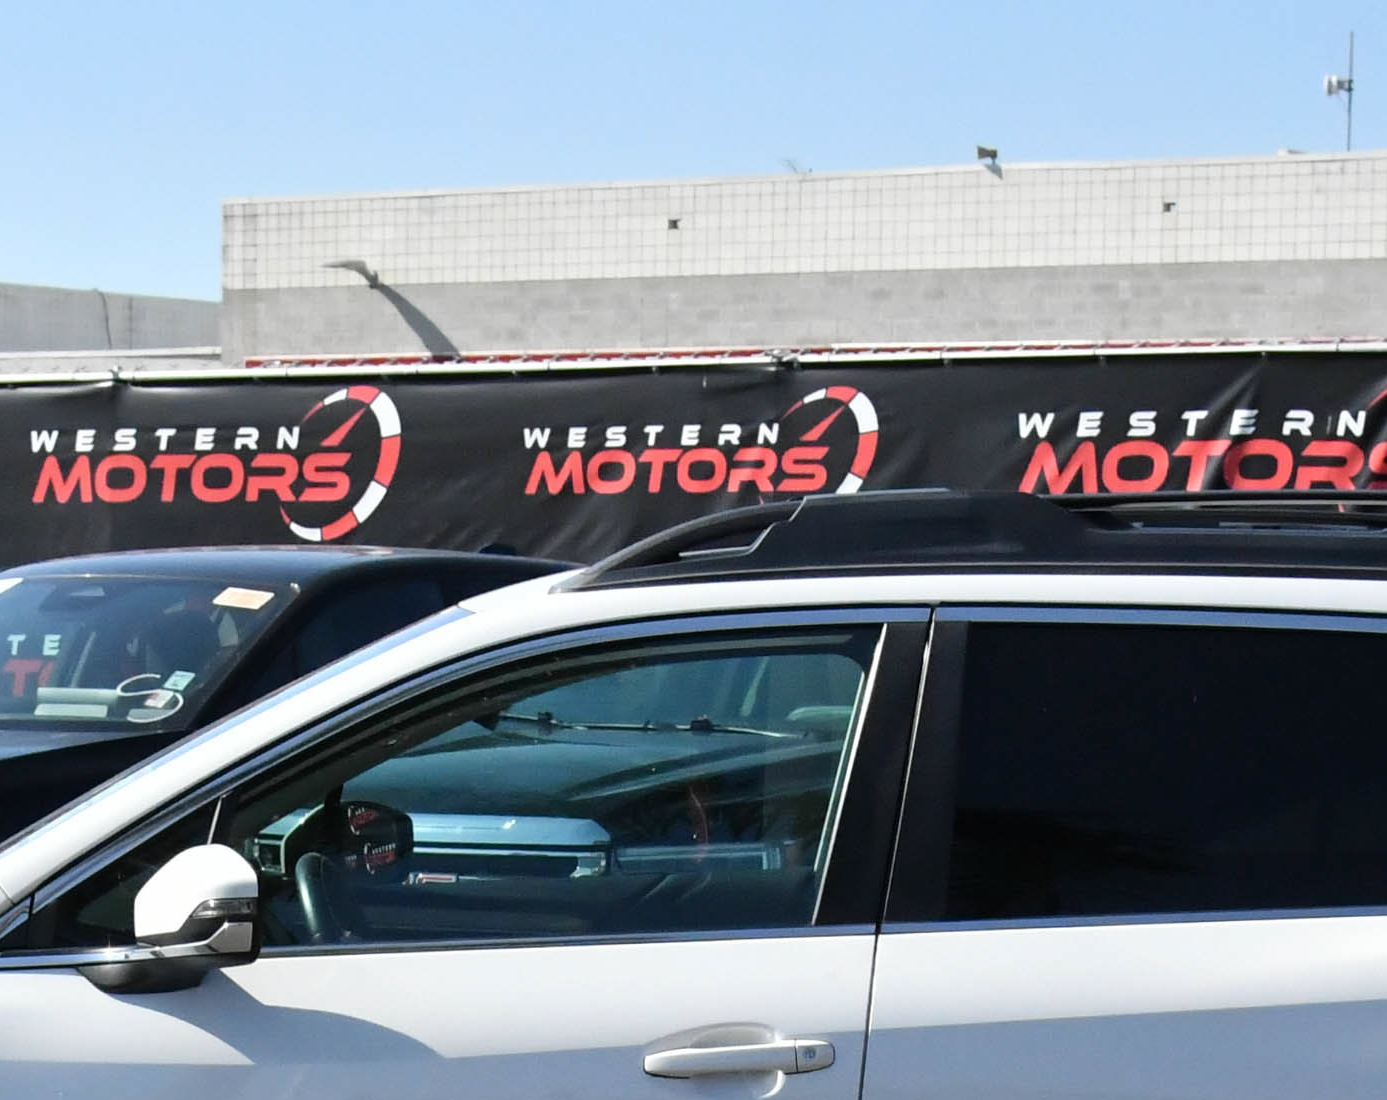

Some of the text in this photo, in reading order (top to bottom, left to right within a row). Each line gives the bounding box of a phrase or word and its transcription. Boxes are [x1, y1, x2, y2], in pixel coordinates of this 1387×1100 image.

[523, 423, 779, 449] WESTERN
[1018, 409, 1367, 438] WESTERN
[30, 426, 300, 453] WESTERN
[32, 452, 353, 503] MOTORS
[524, 446, 830, 495] MOTORS
